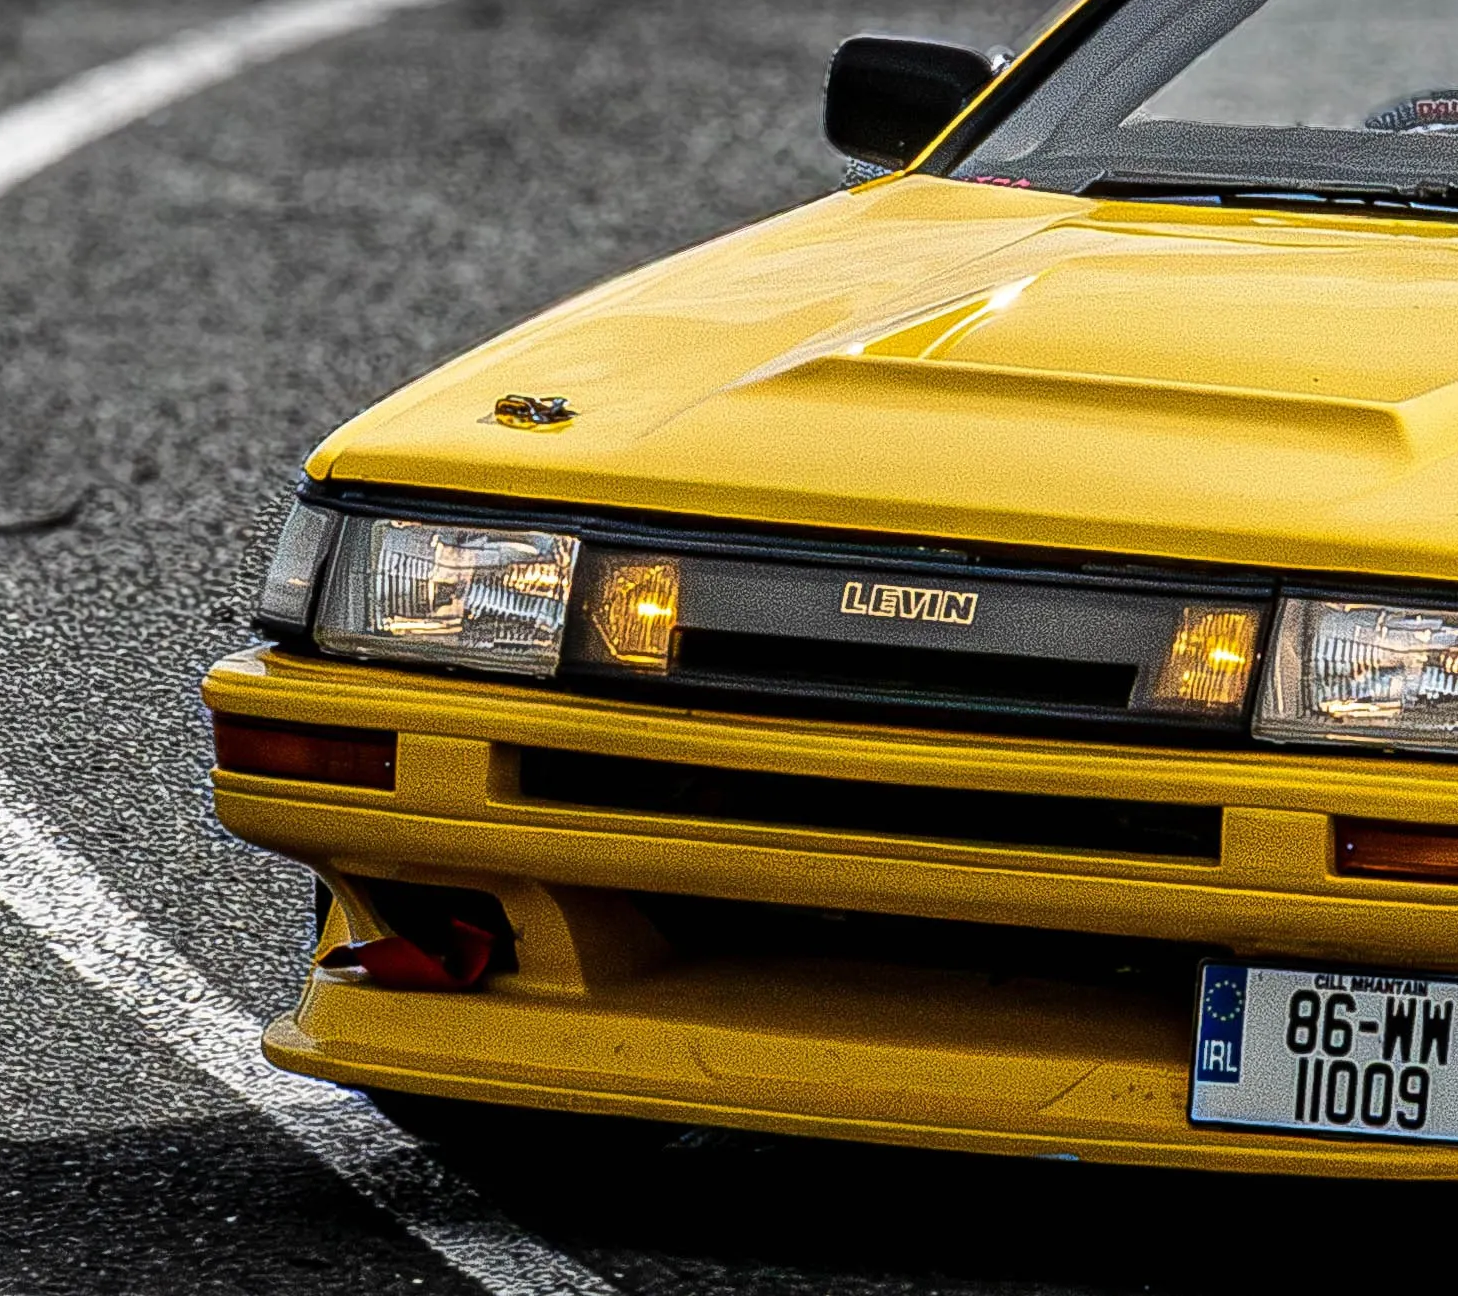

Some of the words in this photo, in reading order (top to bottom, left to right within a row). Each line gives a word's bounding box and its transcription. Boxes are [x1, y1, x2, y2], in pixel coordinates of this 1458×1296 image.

[840, 581, 979, 625] LEVIN
[1314, 974, 1348, 992] CILL
[1286, 989, 1454, 1066] 86-WW
[1202, 1039, 1238, 1073] IRL
[1294, 1057, 1430, 1130] 11009
